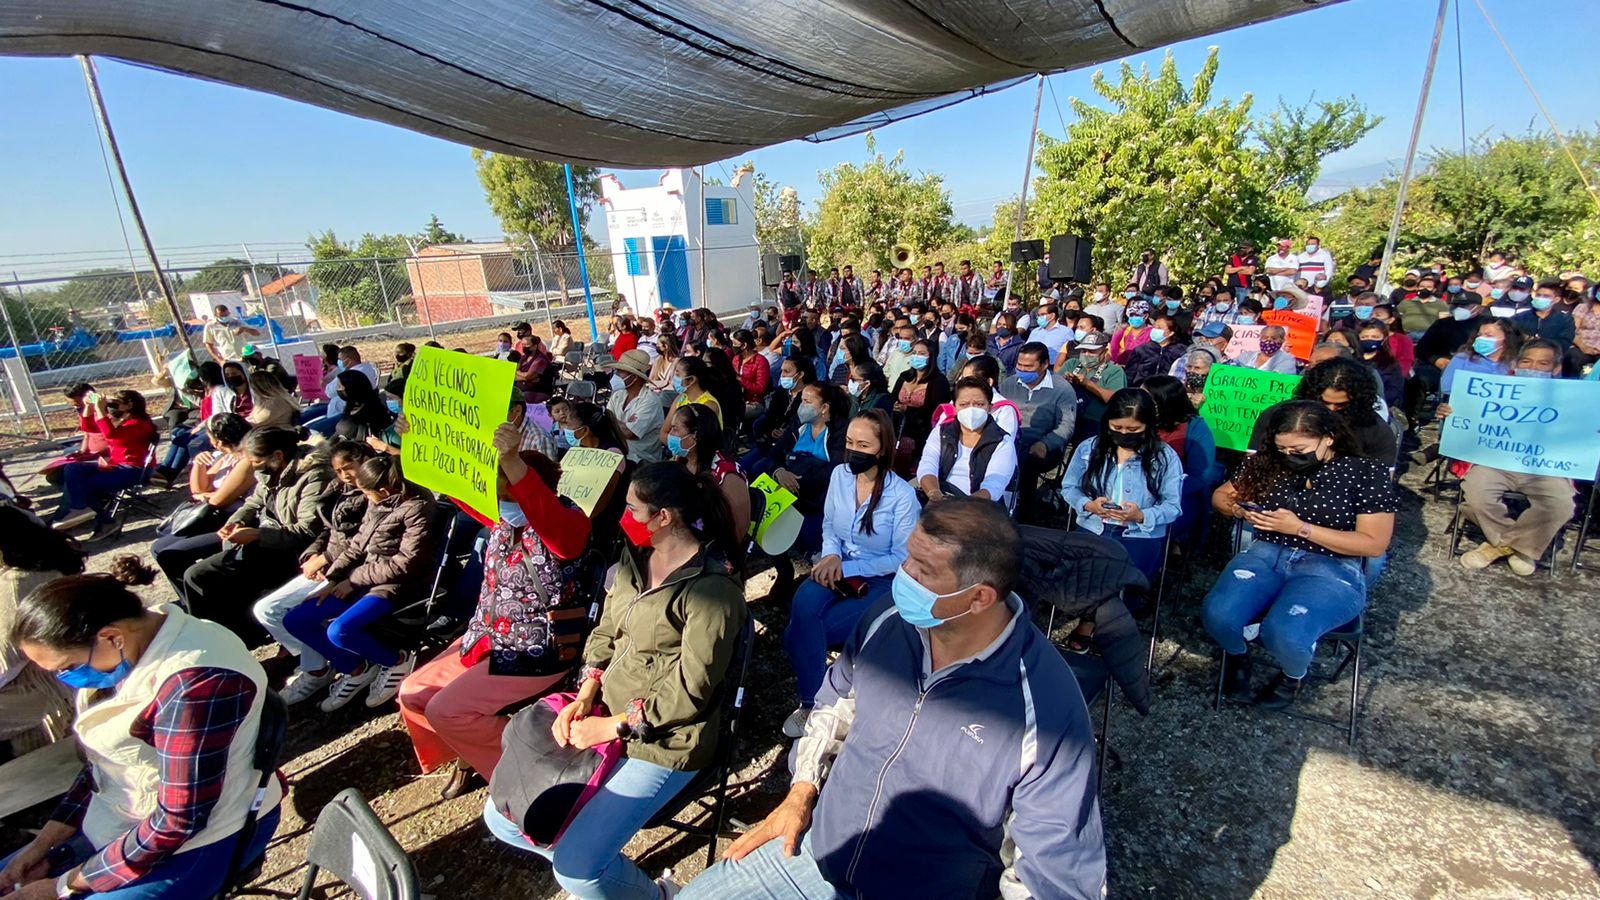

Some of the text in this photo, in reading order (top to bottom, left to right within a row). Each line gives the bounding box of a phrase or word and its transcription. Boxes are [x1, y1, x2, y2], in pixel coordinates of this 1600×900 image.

[1234, 330, 1260, 339] CIAS
[433, 357, 477, 398] VECINOS
[1211, 368, 1258, 389] GRACIAS
[1208, 389, 1227, 401] POR
[1233, 390, 1247, 402] TU
[1467, 377, 1526, 400] ESTE
[408, 384, 480, 430] AGRADECEMOS
[1208, 403, 1260, 419] HOY TEN
[1481, 401, 1559, 424] POZO
[1215, 418, 1241, 433] POZO
[1451, 416, 1512, 439] ES UNA
[410, 413, 499, 471] POR LA PERFORACION
[1478, 436, 1545, 456] REALIDAD
[412, 442, 487, 497] DEL POZO DE AGUA
[564, 449, 618, 469] TENEMOS
[574, 485, 593, 499] EN
